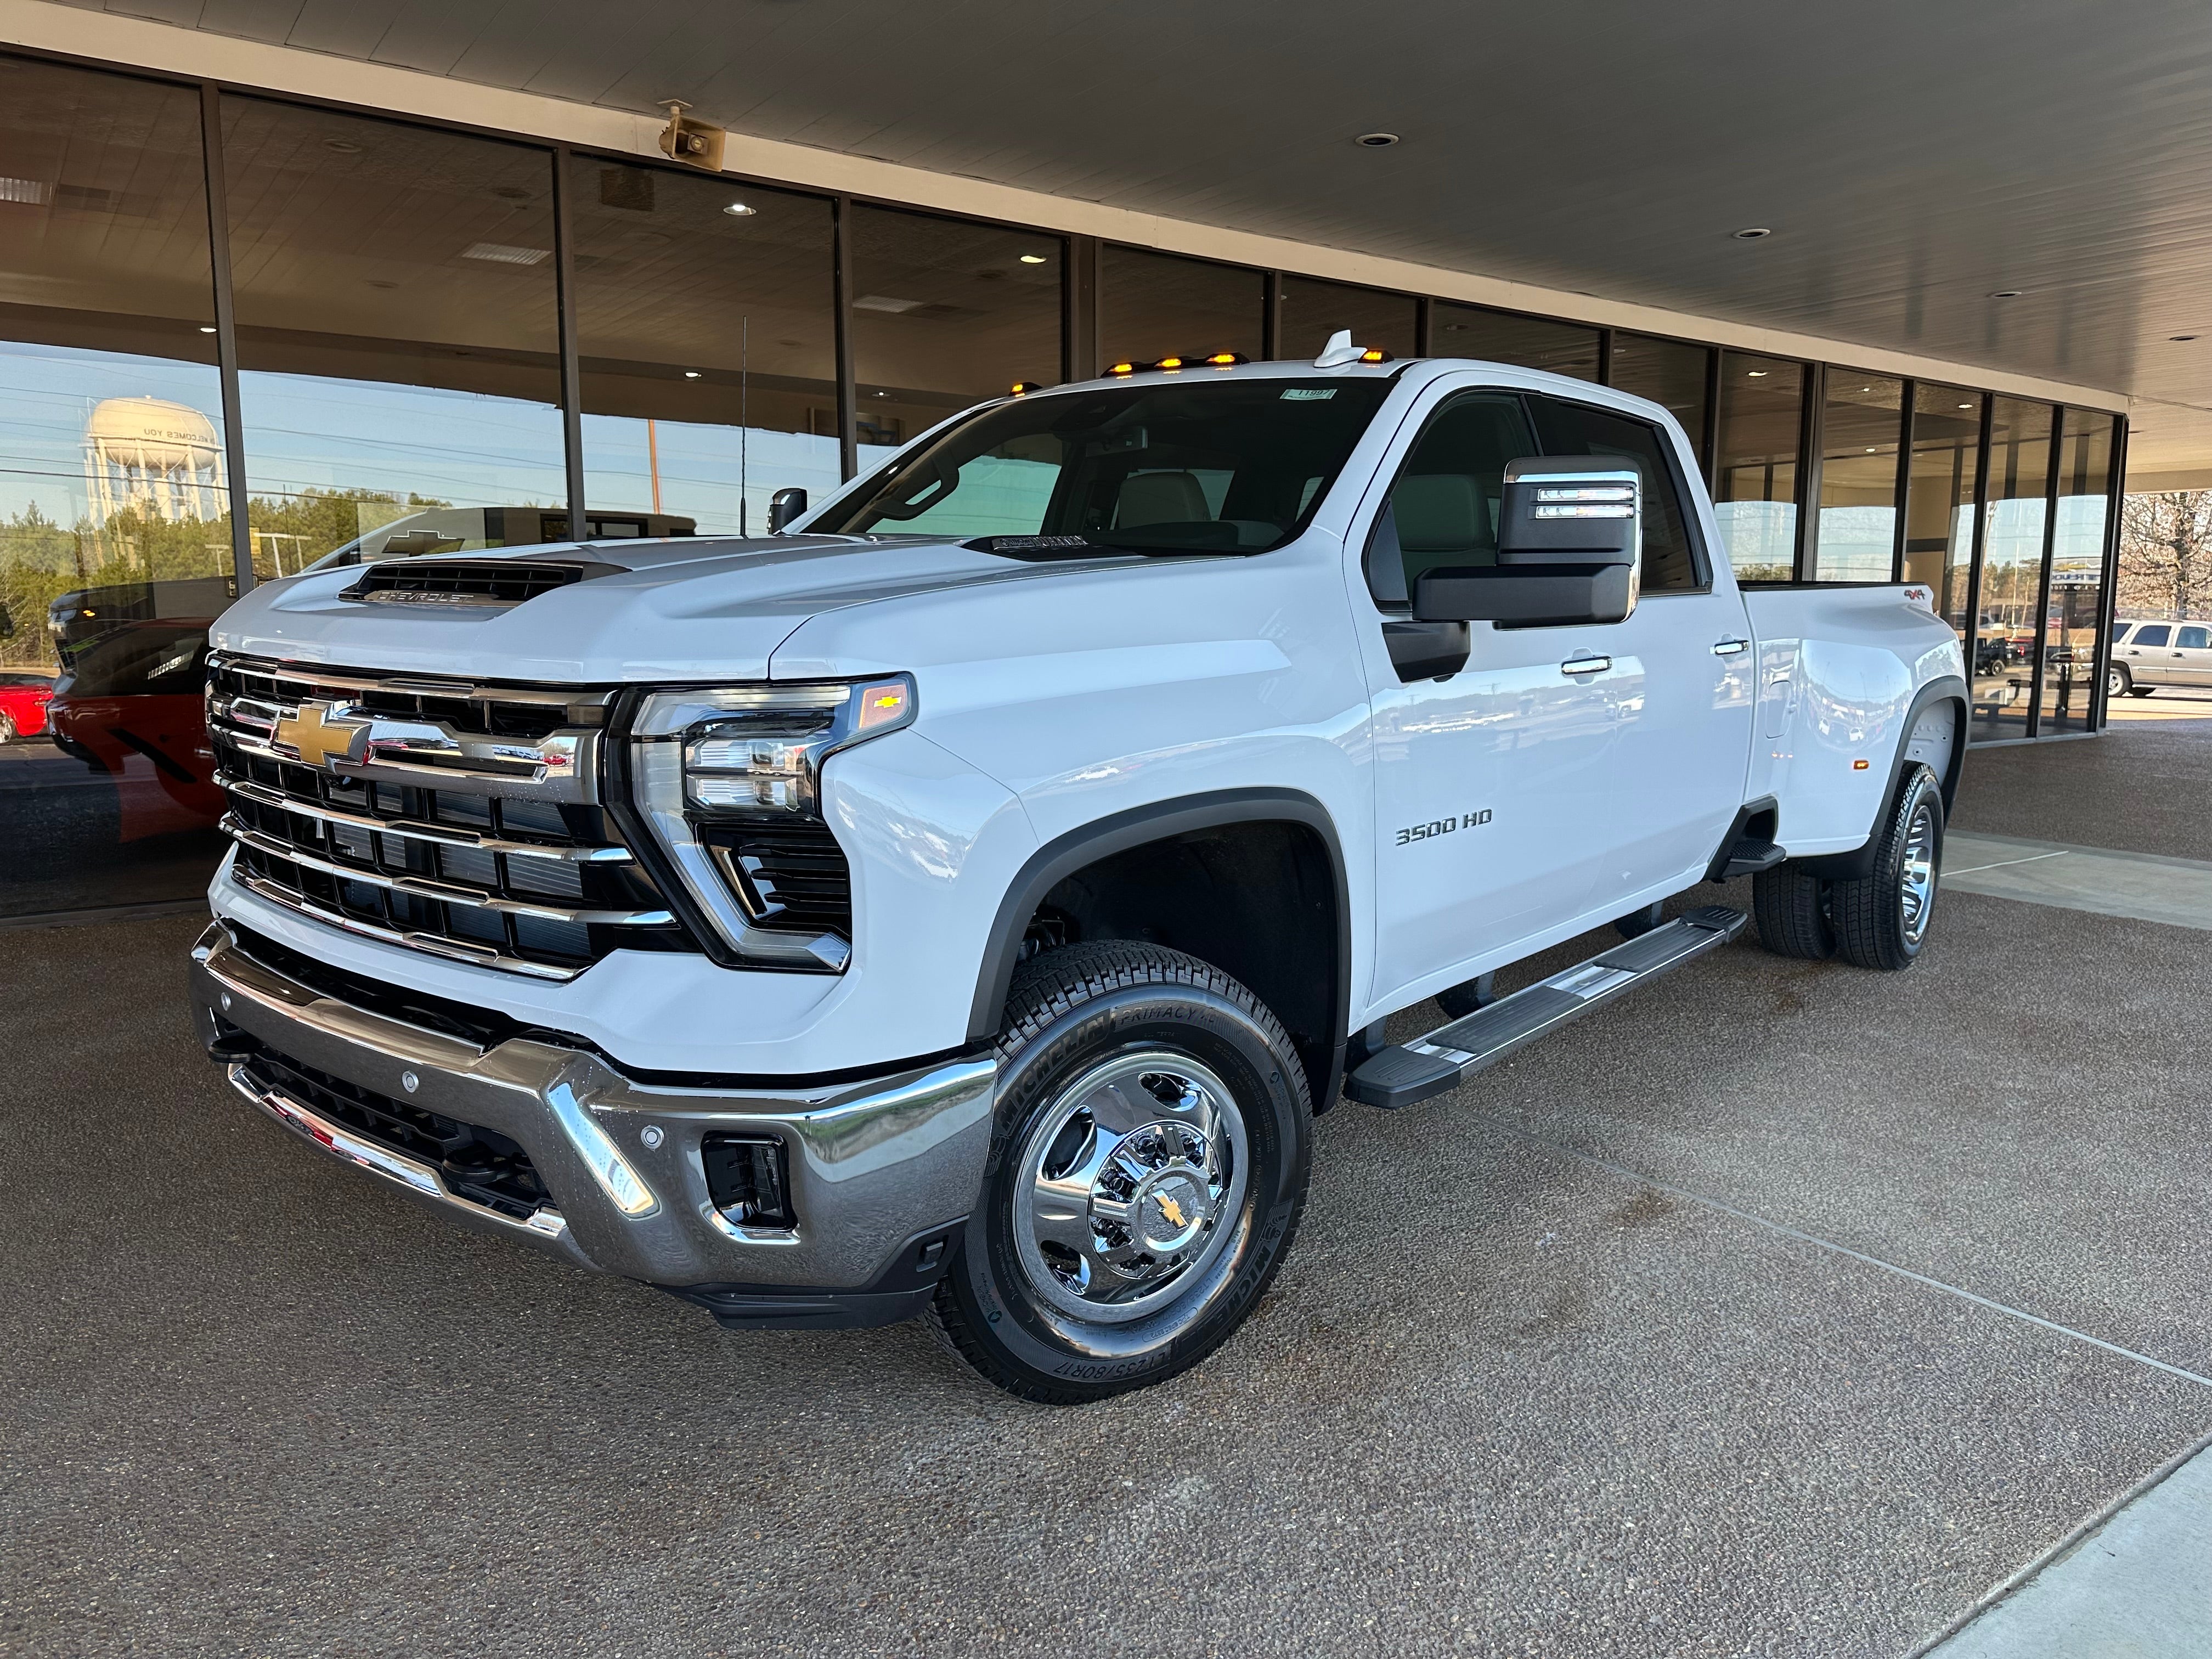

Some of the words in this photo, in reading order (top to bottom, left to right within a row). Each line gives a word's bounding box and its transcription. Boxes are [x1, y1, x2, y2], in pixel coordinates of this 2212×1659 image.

[378, 592, 474, 602] CHEVROLET
[1395, 816, 1457, 846] 3500
[1462, 809, 1492, 829] HD
[996, 1015, 1105, 1131] MICHELIN
[1120, 1005, 1197, 1025] PRIMACY
[1178, 1245, 1271, 1350] MICHE
[1053, 1351, 1171, 1379] LT235/80R17
